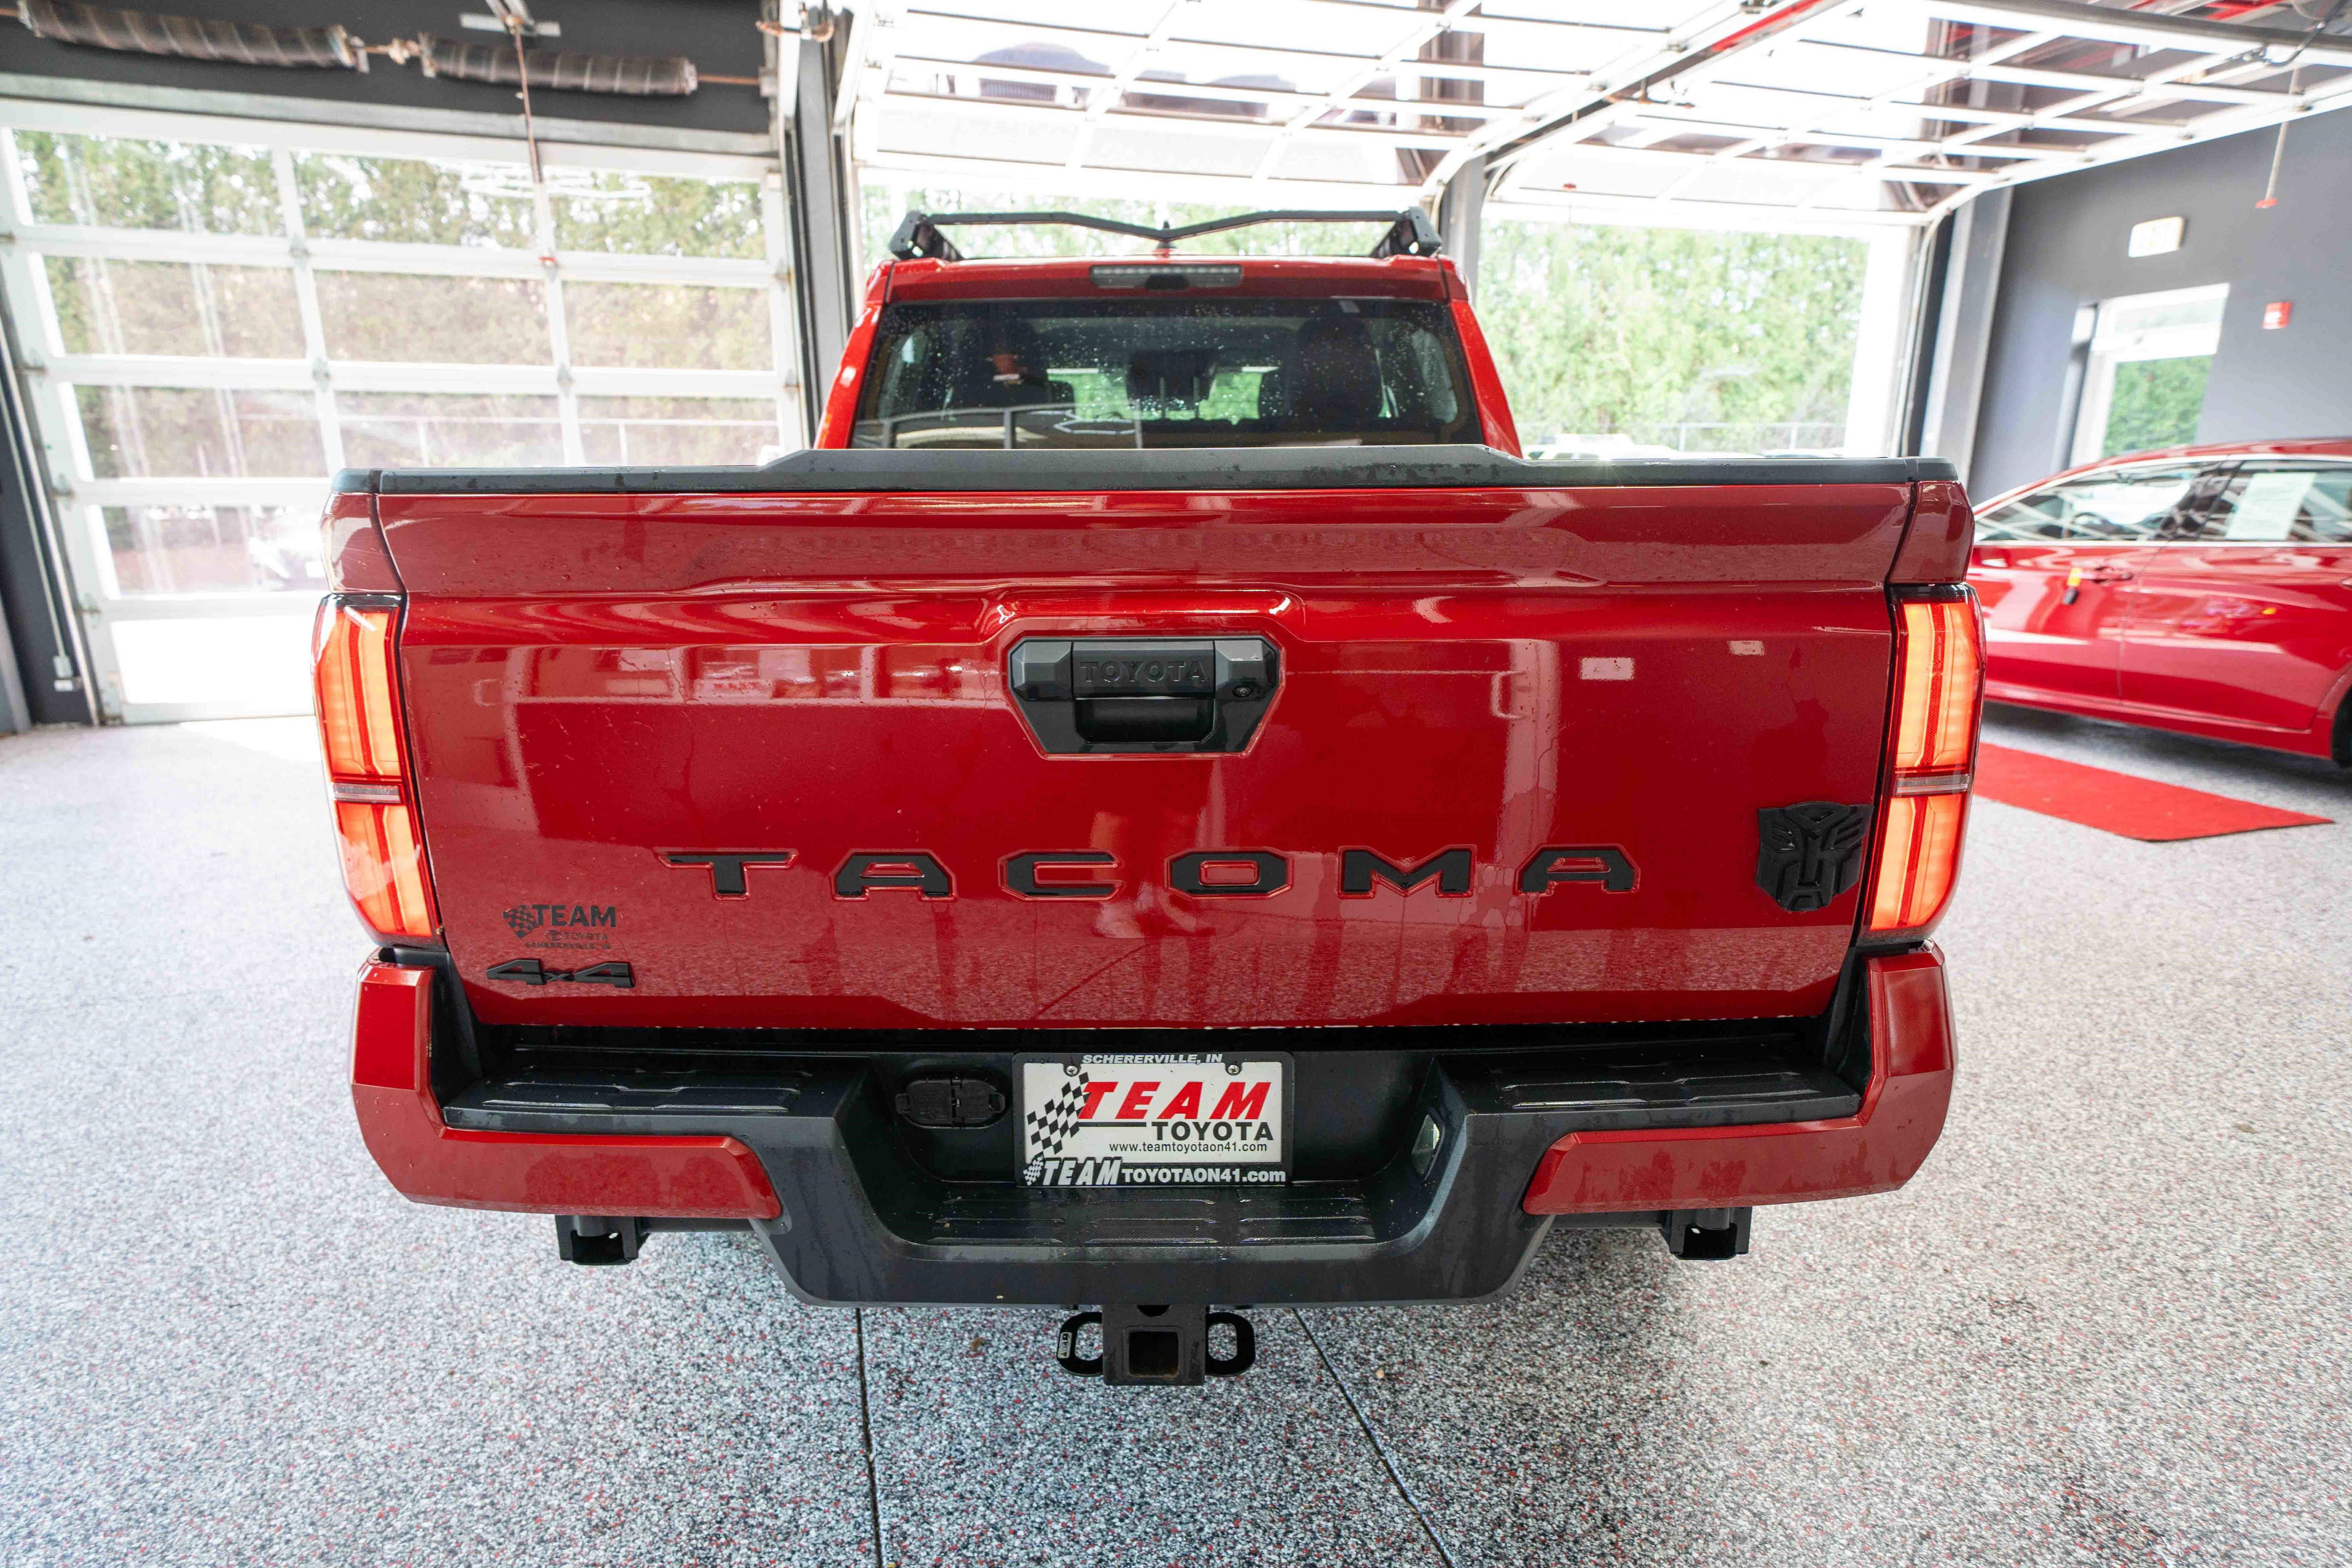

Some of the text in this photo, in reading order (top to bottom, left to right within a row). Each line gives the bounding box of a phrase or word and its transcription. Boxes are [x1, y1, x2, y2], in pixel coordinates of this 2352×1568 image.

[1079, 660, 1208, 683] TOYOTA
[654, 843, 1640, 902] TACOMA
[531, 904, 616, 927] TEAM
[1082, 1054, 1223, 1065] SCHERERVILLE, IN
[1078, 1081, 1272, 1120] TEAM
[1152, 1121, 1274, 1141] TOYOTA
[1109, 1142, 1268, 1154] www.teamtoyotaon41.com
[1042, 1159, 1286, 1185] TEAM TOYOTAON41.com
